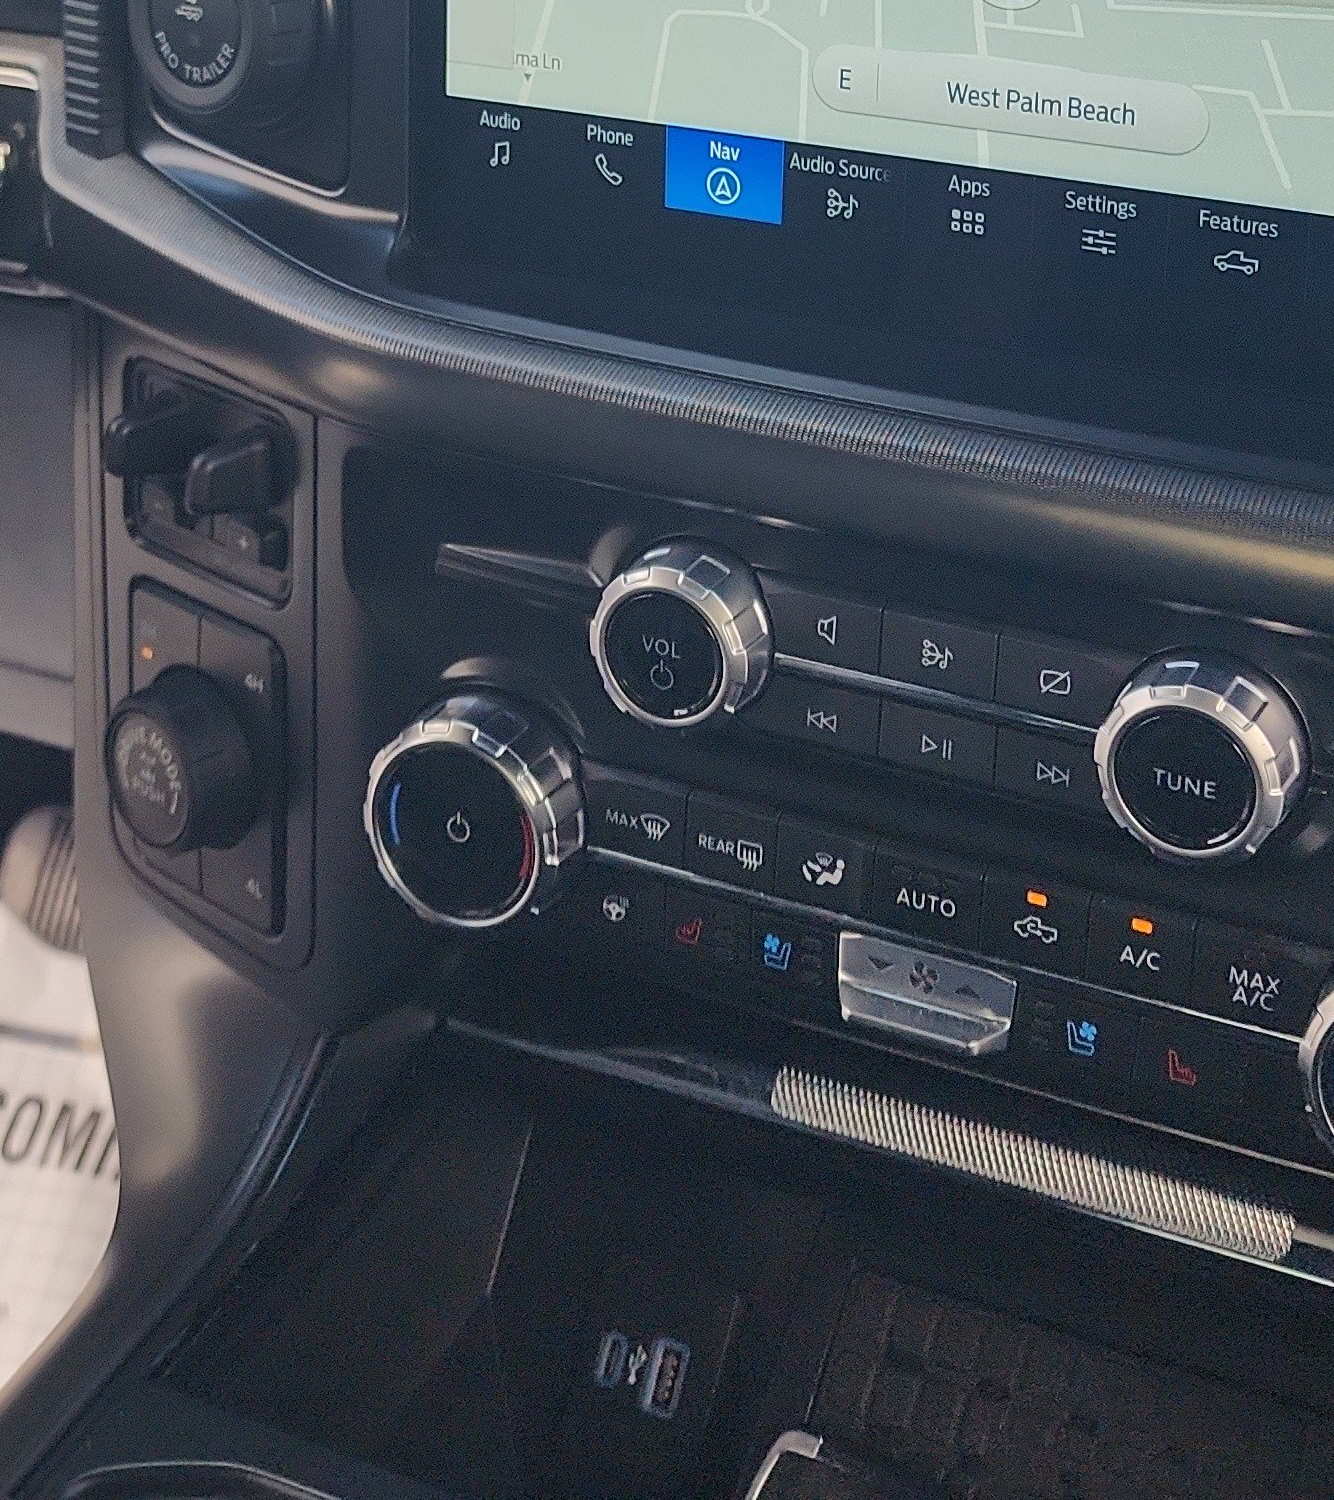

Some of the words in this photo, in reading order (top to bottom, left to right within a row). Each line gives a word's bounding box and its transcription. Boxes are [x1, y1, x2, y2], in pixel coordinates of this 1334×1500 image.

[154, 31, 179, 69] PRO
[182, 43, 235, 83] TRAILER
[543, 52, 561, 71] Ln
[839, 68, 852, 90] E
[946, 81, 1001, 110] West
[1005, 87, 1063, 118] Palm
[1067, 97, 1137, 127] Beach
[479, 110, 522, 133] Audio
[586, 124, 634, 148] Phone
[709, 141, 741, 161] Nav
[789, 152, 835, 175] Audio
[948, 176, 991, 200] Apps
[1065, 190, 1138, 220] Settings
[1198, 209, 1279, 239] Features
[642, 635, 681, 659] VOL
[1153, 768, 1217, 800] TUNE
[605, 809, 639, 829] MAX
[698, 835, 735, 855] REAR
[896, 887, 957, 918] AUTO
[1120, 943, 1161, 973] A/C
[1229, 965, 1281, 997] MAX
[1232, 987, 1275, 1013] A/C
